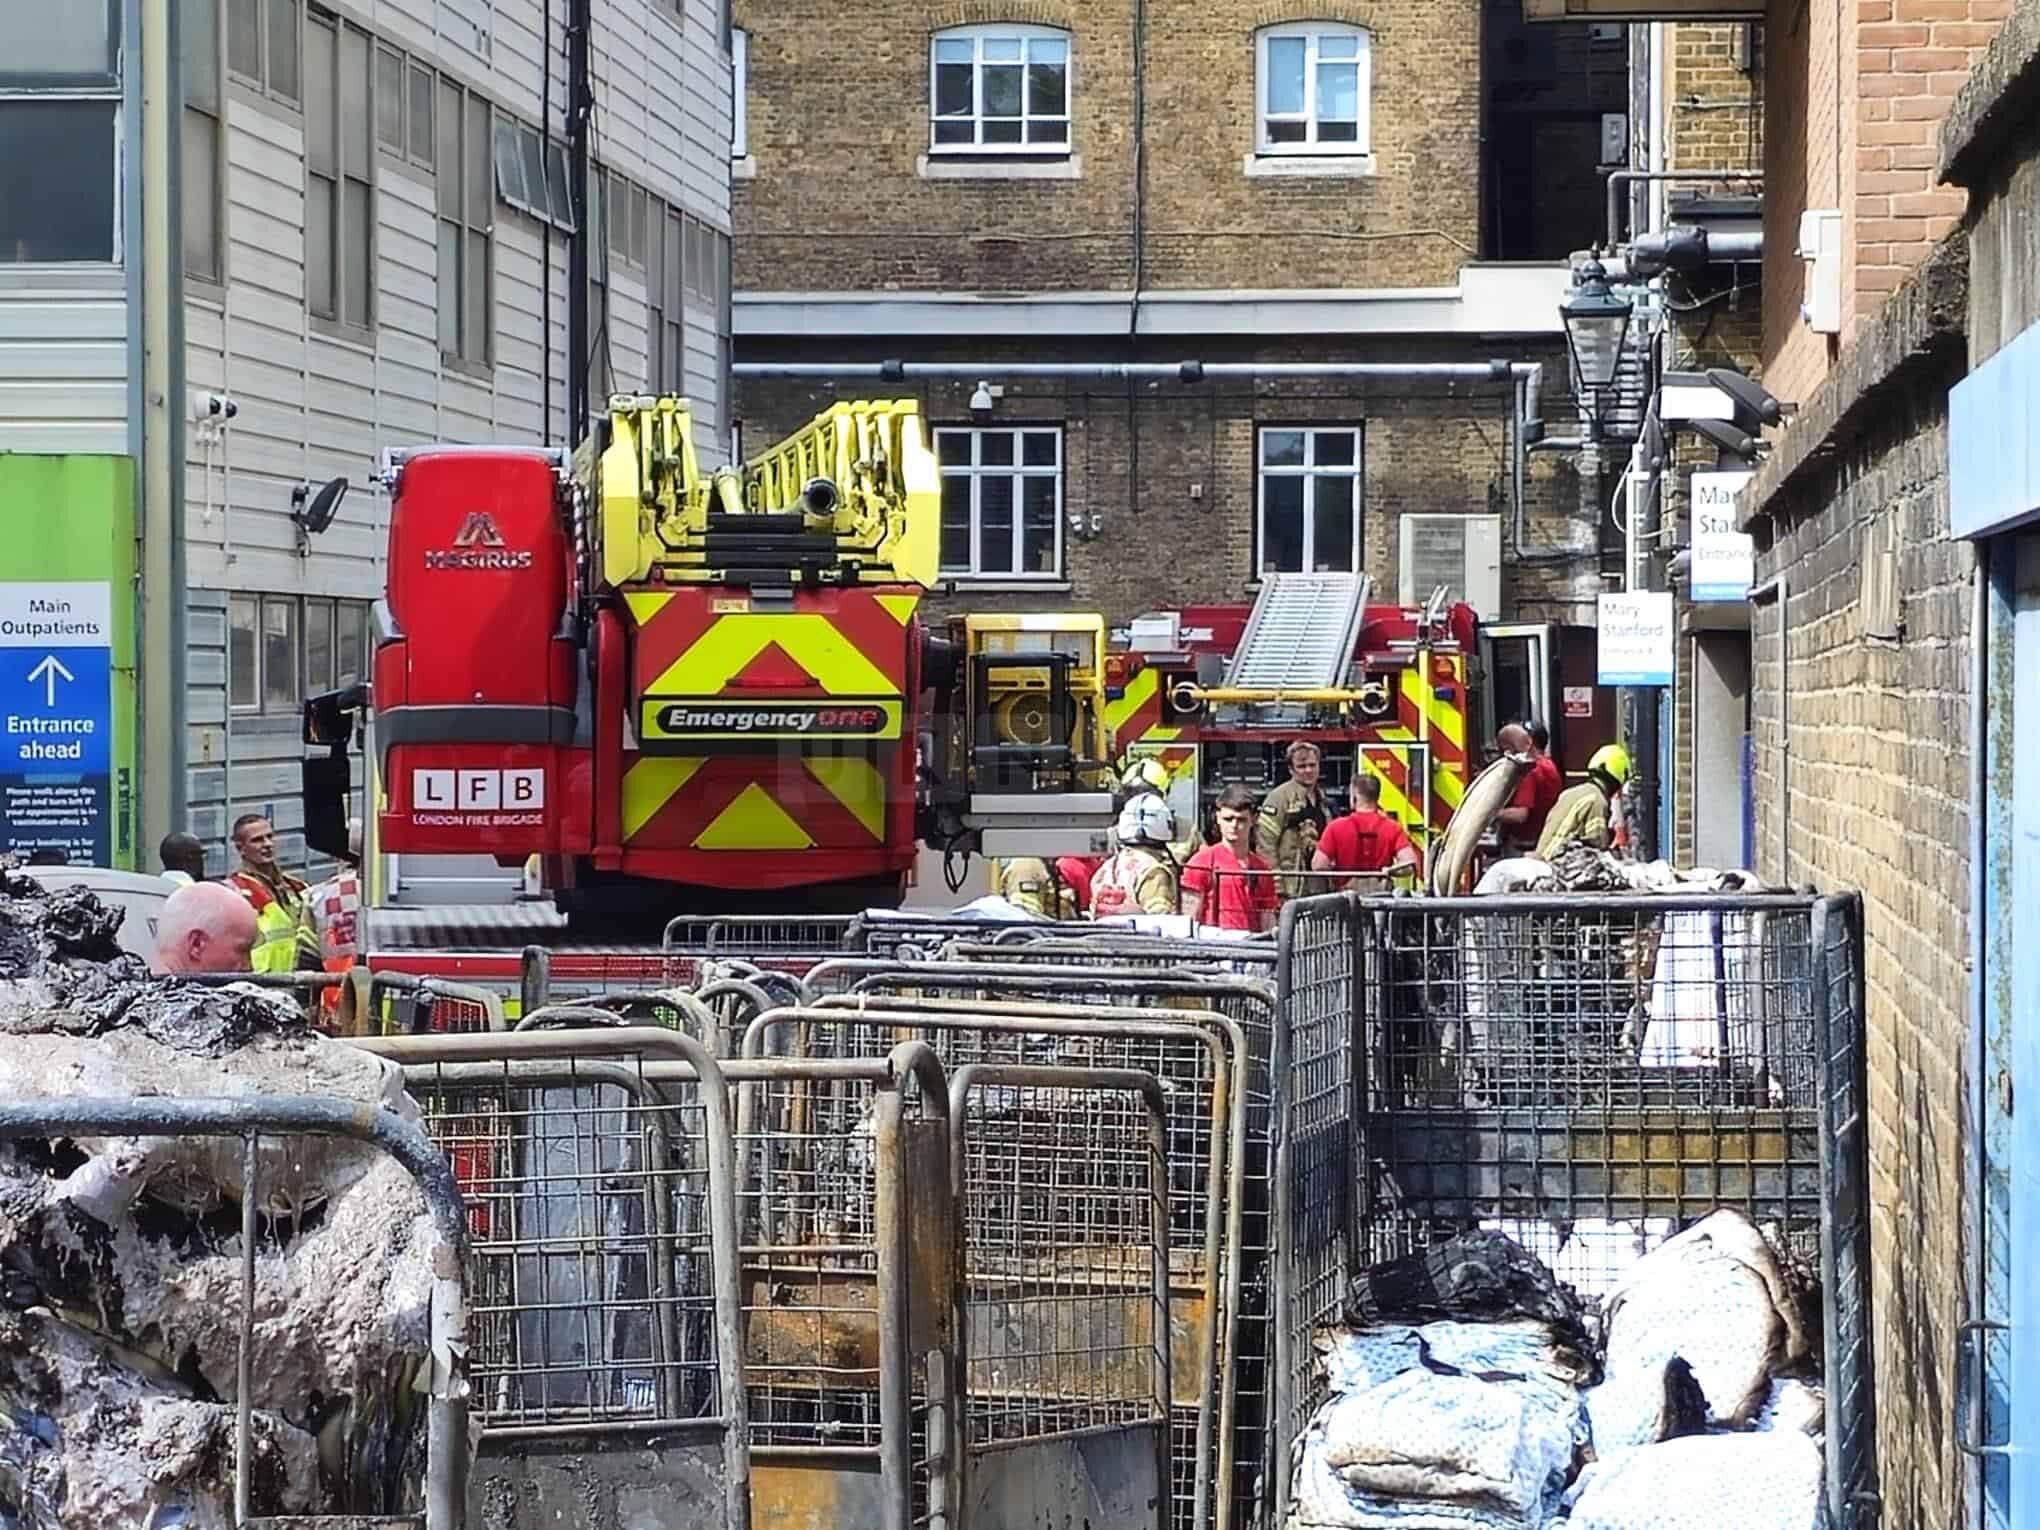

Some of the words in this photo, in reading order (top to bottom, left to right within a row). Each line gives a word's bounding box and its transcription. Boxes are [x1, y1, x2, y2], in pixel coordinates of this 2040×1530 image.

[424, 550, 532, 569] MAGIRUS
[29, 599, 71, 613] Main
[1, 620, 100, 637] Outpatients
[7, 716, 95, 734] Entrance
[668, 708, 817, 731] Emergency
[19, 740, 81, 760] ahead
[412, 814, 463, 826] LONDON
[465, 815, 491, 826] FIRE
[493, 814, 544, 826] BRIGADE
